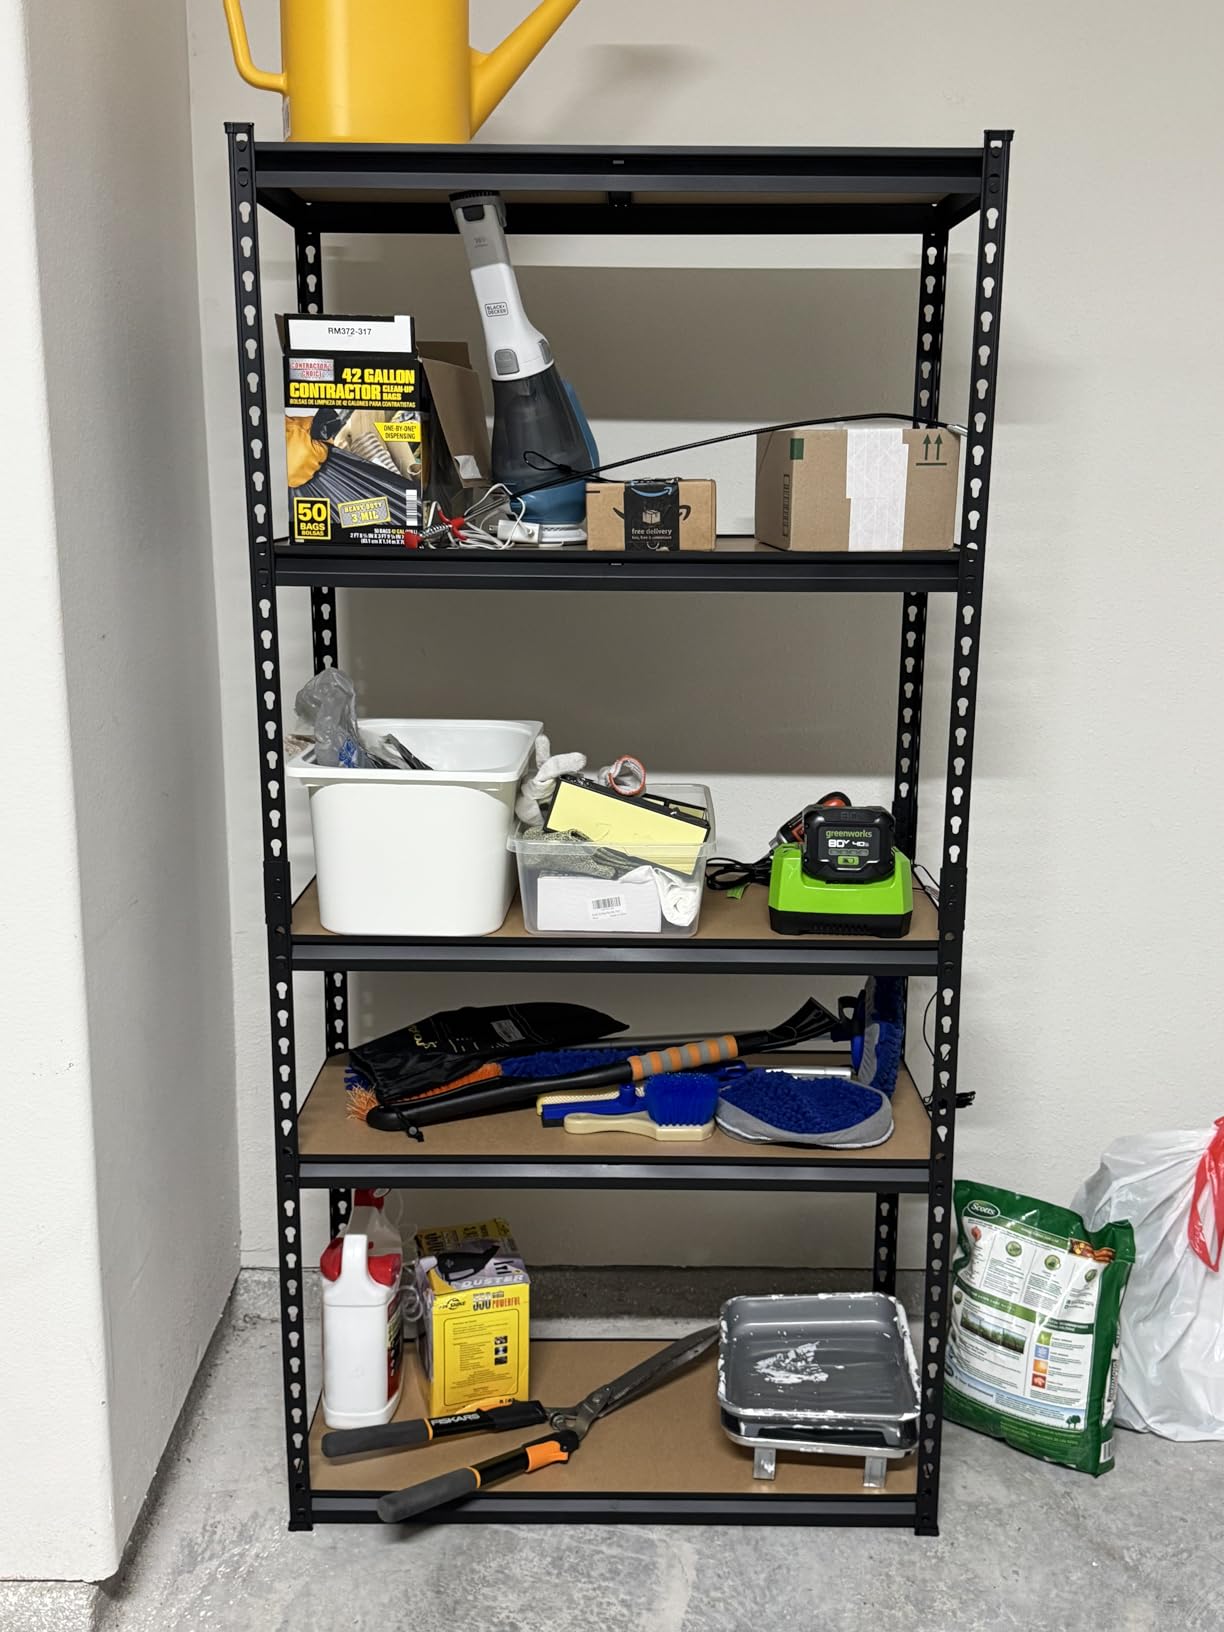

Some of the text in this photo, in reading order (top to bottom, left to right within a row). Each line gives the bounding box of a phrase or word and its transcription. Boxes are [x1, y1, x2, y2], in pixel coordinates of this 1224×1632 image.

[327, 327, 372, 335] RM372-317
[341, 368, 415, 384] 42 GALLON
[289, 382, 381, 400] CONTRACTOR
[383, 385, 414, 393] CLEAN-UP
[385, 432, 416, 440] DISPENSING
[298, 503, 327, 522] 50
[351, 511, 379, 523] 3 MIL
[300, 522, 325, 531] BAGS
[825, 829, 873, 839] greenworks
[828, 839, 850, 848] 80V
[970, 1202, 996, 1216] Scotts
[461, 1274, 524, 1288] DUSTER
[430, 1413, 480, 1426] FISKARS
